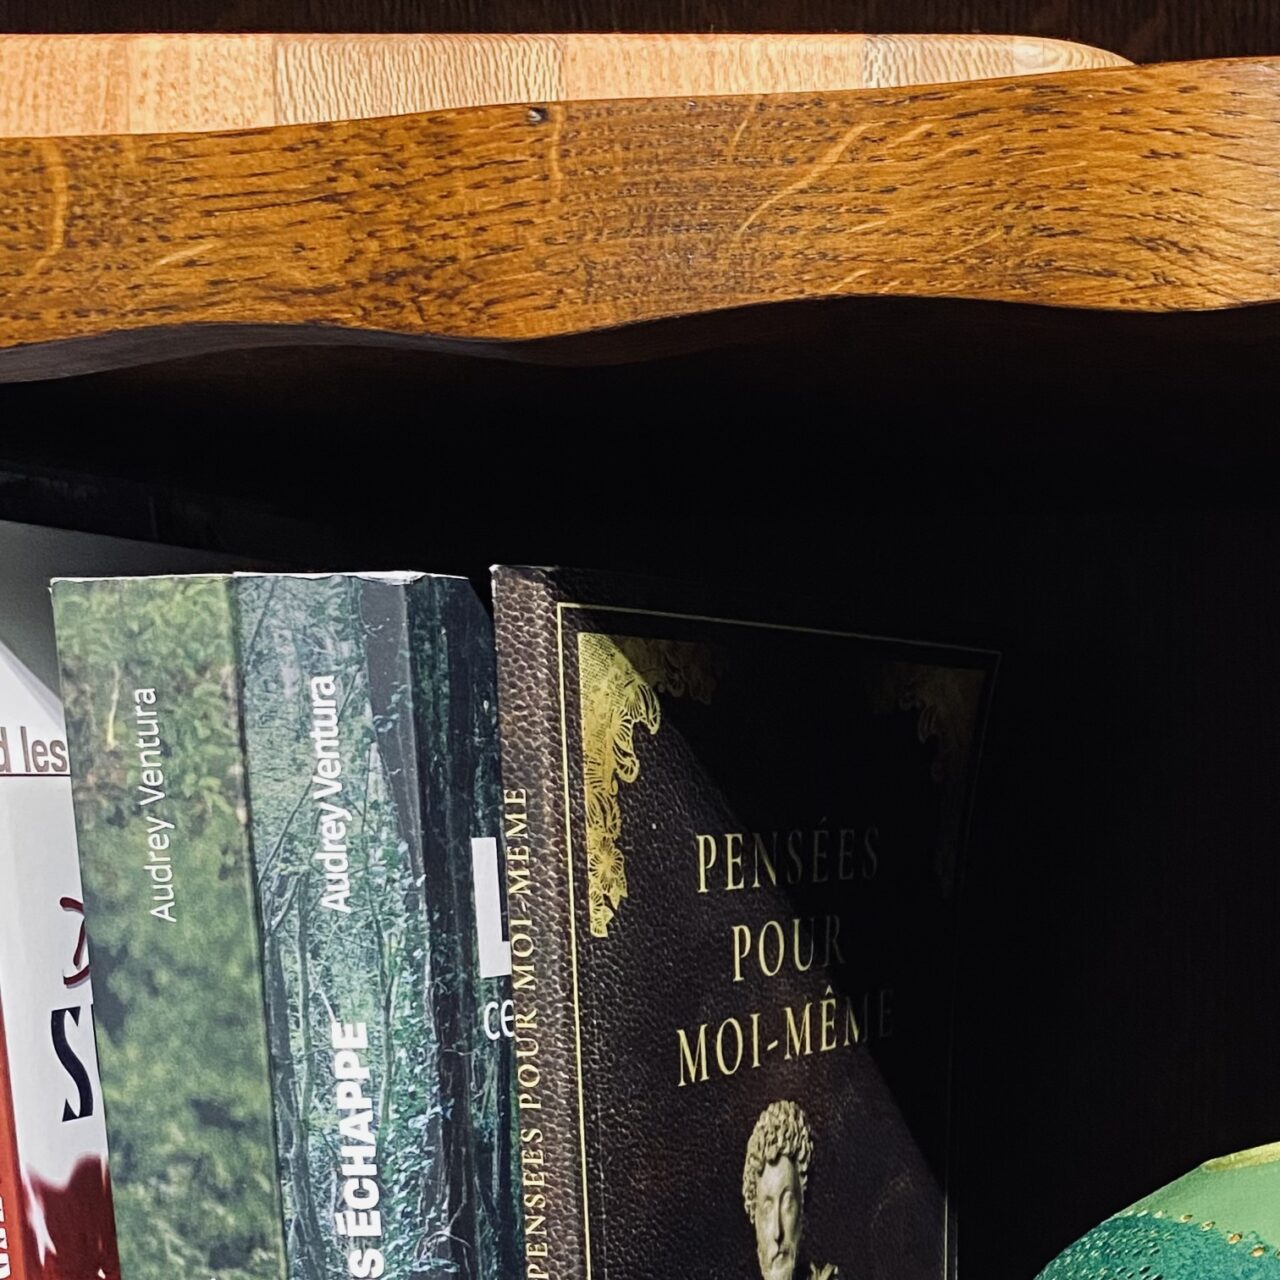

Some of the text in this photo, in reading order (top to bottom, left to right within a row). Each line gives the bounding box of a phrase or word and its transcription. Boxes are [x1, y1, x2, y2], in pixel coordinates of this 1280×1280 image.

[20, 726, 68, 773] les
[310, 674, 353, 914] Audrey Ventura
[134, 687, 177, 923] Audrey Ventura
[695, 816, 880, 894] PENSÉES
[731, 915, 847, 983] POUR
[515, 1008, 542, 1110] POUR
[676, 984, 896, 1088] MOI-MÊME
[331, 1021, 382, 1237] ÉCHAPPE
